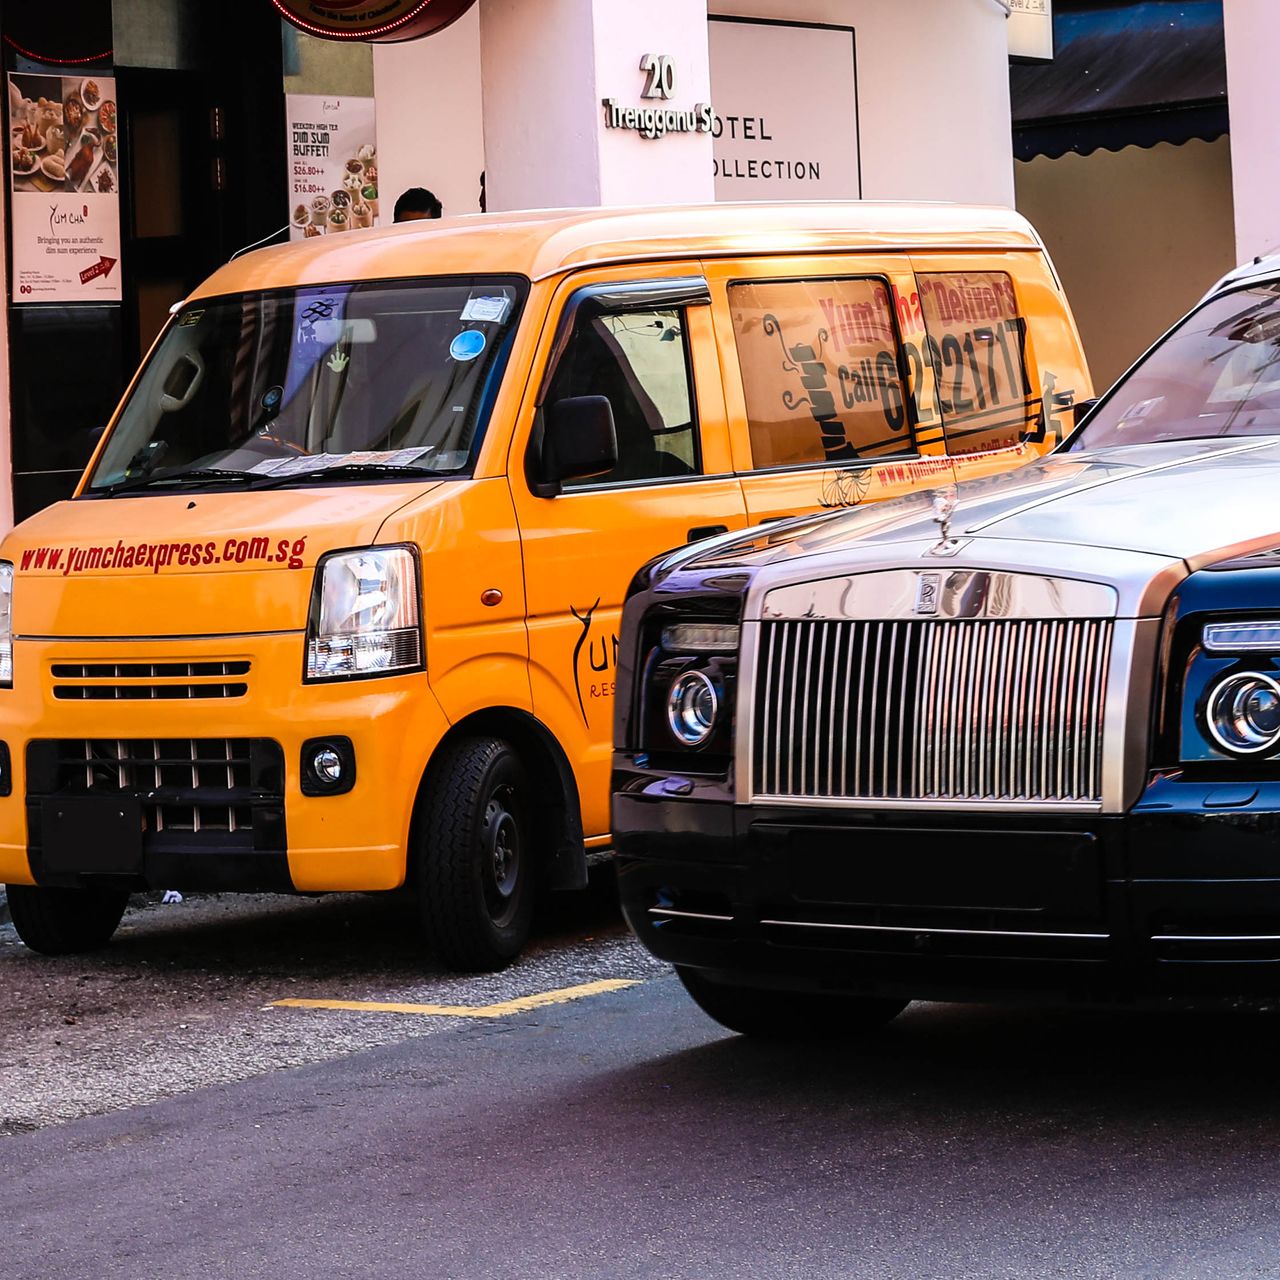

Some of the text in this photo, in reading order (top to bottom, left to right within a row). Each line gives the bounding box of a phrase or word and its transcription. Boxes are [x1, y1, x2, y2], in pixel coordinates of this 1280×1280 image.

[639, 53, 678, 100] 20
[602, 97, 716, 140] Trengganu St
[711, 116, 773, 141] OTEL
[292, 131, 330, 144] DIM SUM
[293, 144, 329, 157] BUFFET!
[713, 158, 821, 180] LLECTION
[49, 204, 67, 236] YUM
[69, 213, 85, 225] CHA
[37, 236, 60, 245] Bringing
[61, 237, 71, 245] you
[79, 236, 104, 244] authentic
[68, 247, 98, 256] experience
[20, 535, 308, 577] www.yumchaexpress.com.sg
